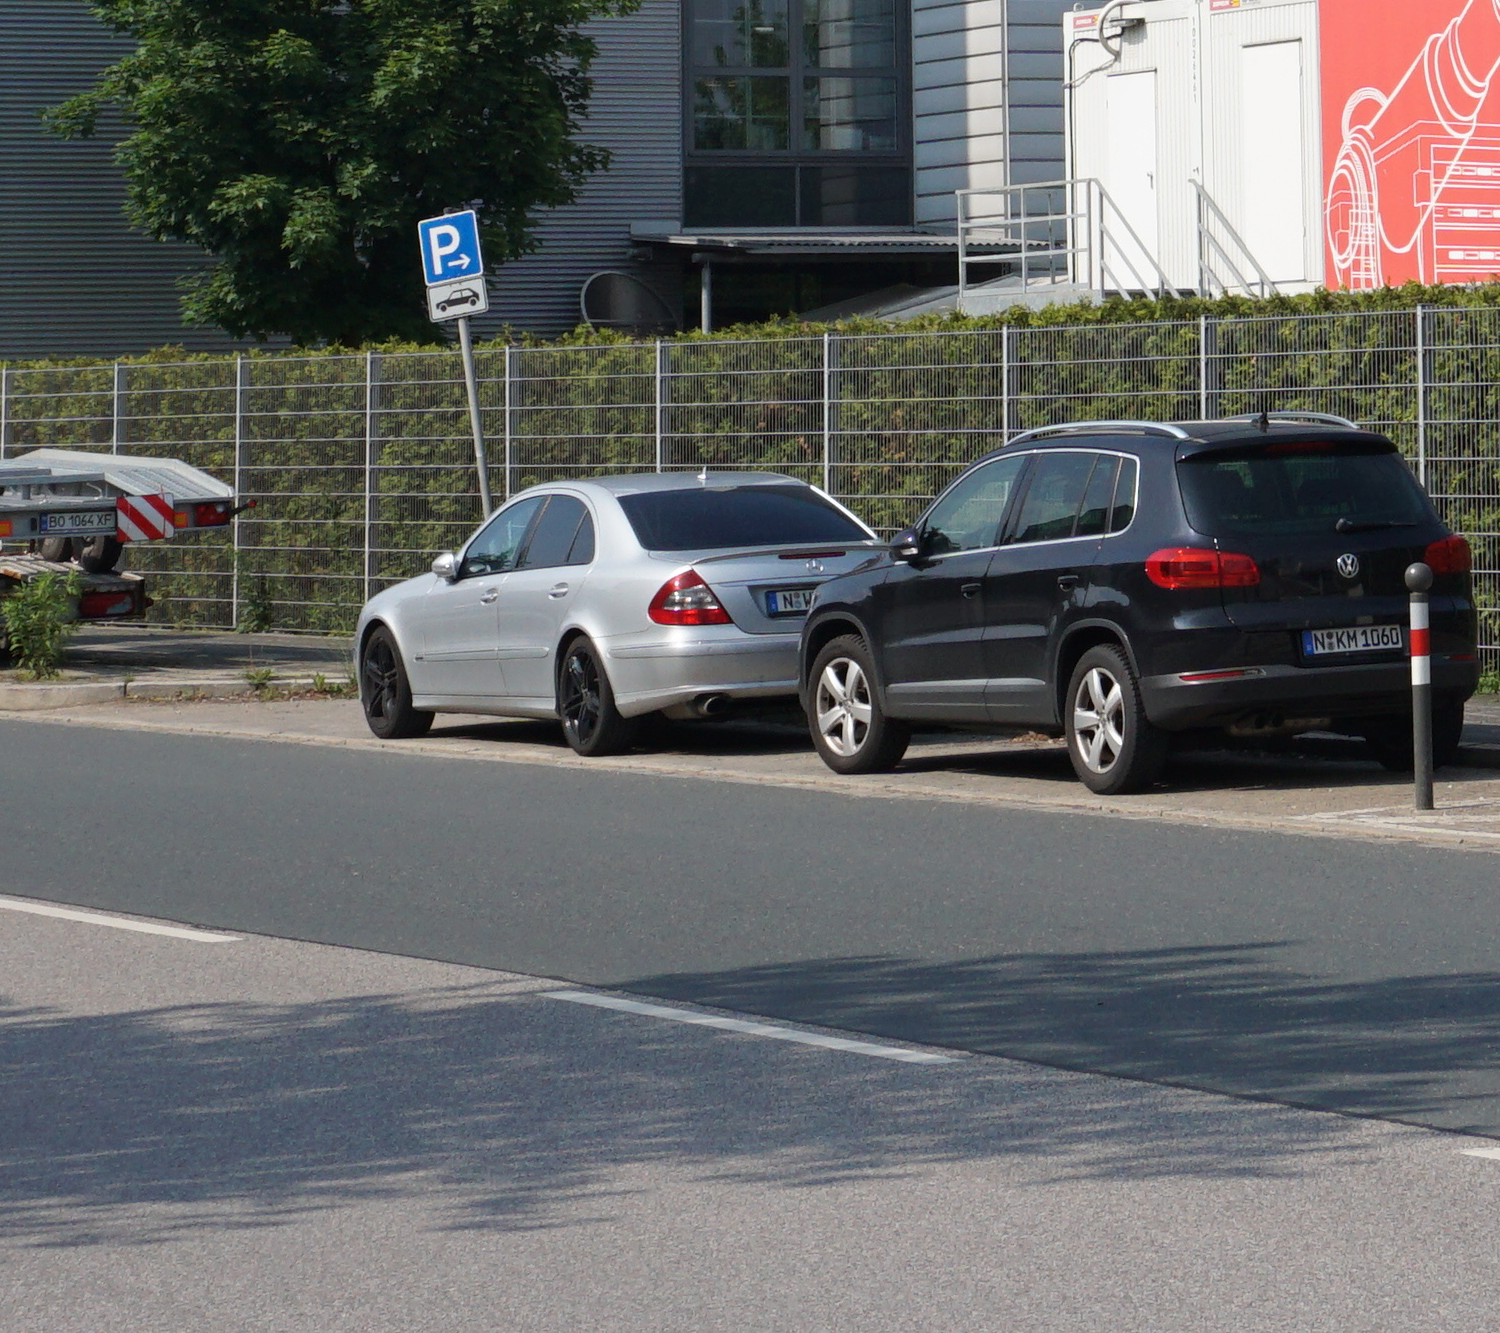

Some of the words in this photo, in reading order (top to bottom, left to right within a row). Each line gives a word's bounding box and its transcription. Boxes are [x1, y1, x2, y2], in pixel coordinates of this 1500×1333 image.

[428, 224, 461, 275] P
[48, 515, 65, 528] BO
[782, 593, 794, 609] N
[1313, 632, 1326, 652] N
[1335, 629, 1359, 650] KM
[1361, 627, 1400, 648] 1060
